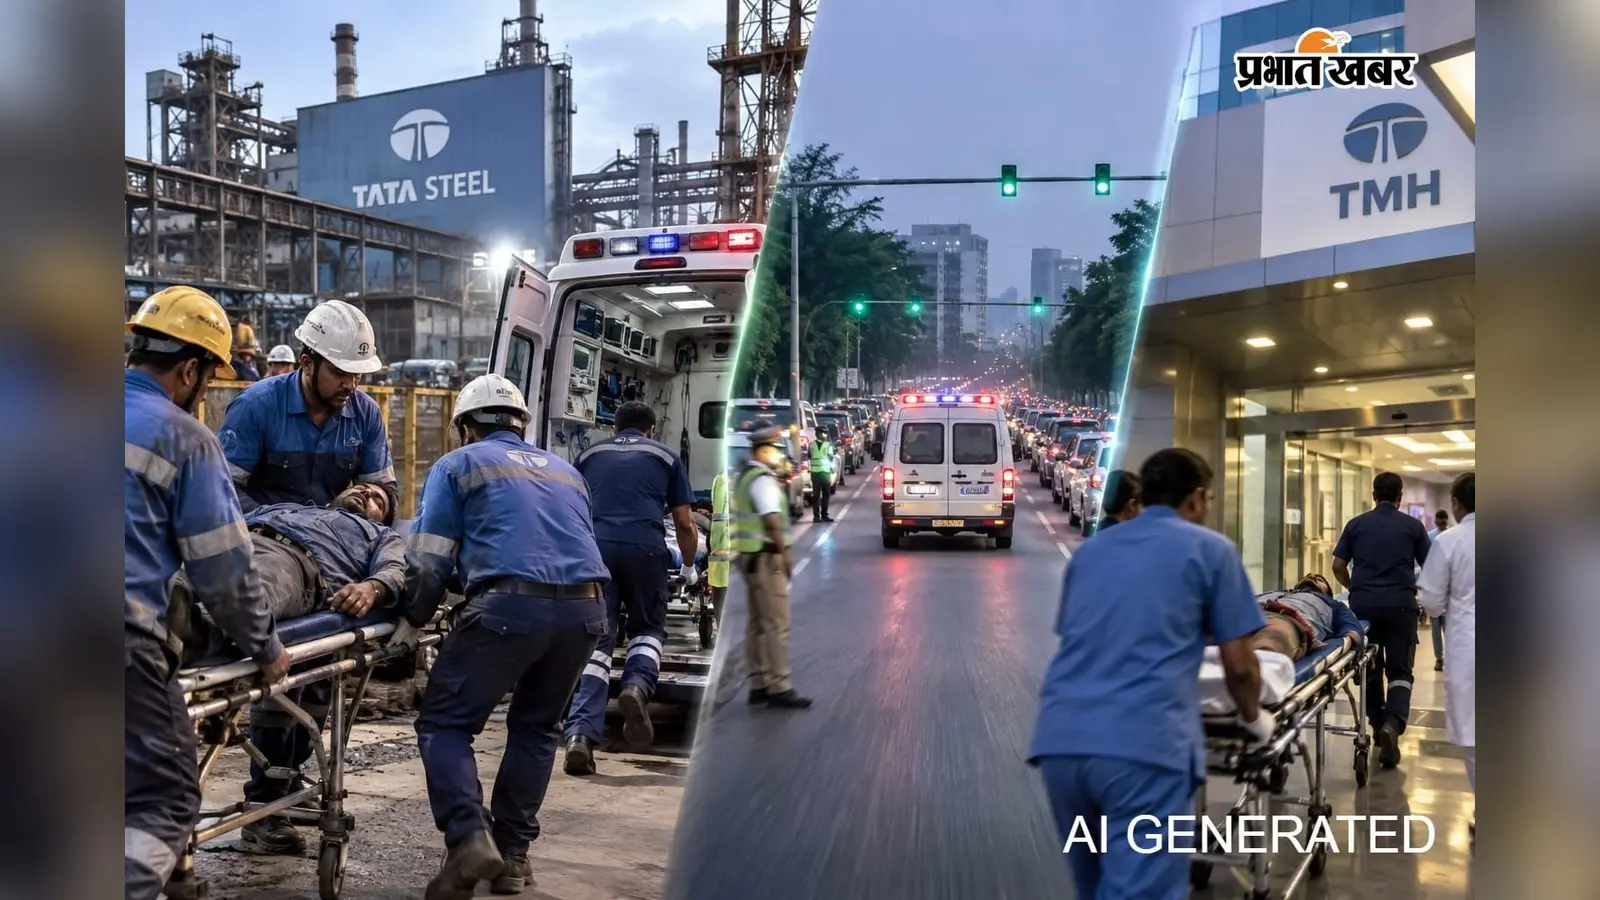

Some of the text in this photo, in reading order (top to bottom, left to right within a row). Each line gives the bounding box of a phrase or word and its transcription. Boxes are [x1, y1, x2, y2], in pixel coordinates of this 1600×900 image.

[352, 170, 496, 208] TATA STEEL
[1329, 169, 1440, 219] TMH
